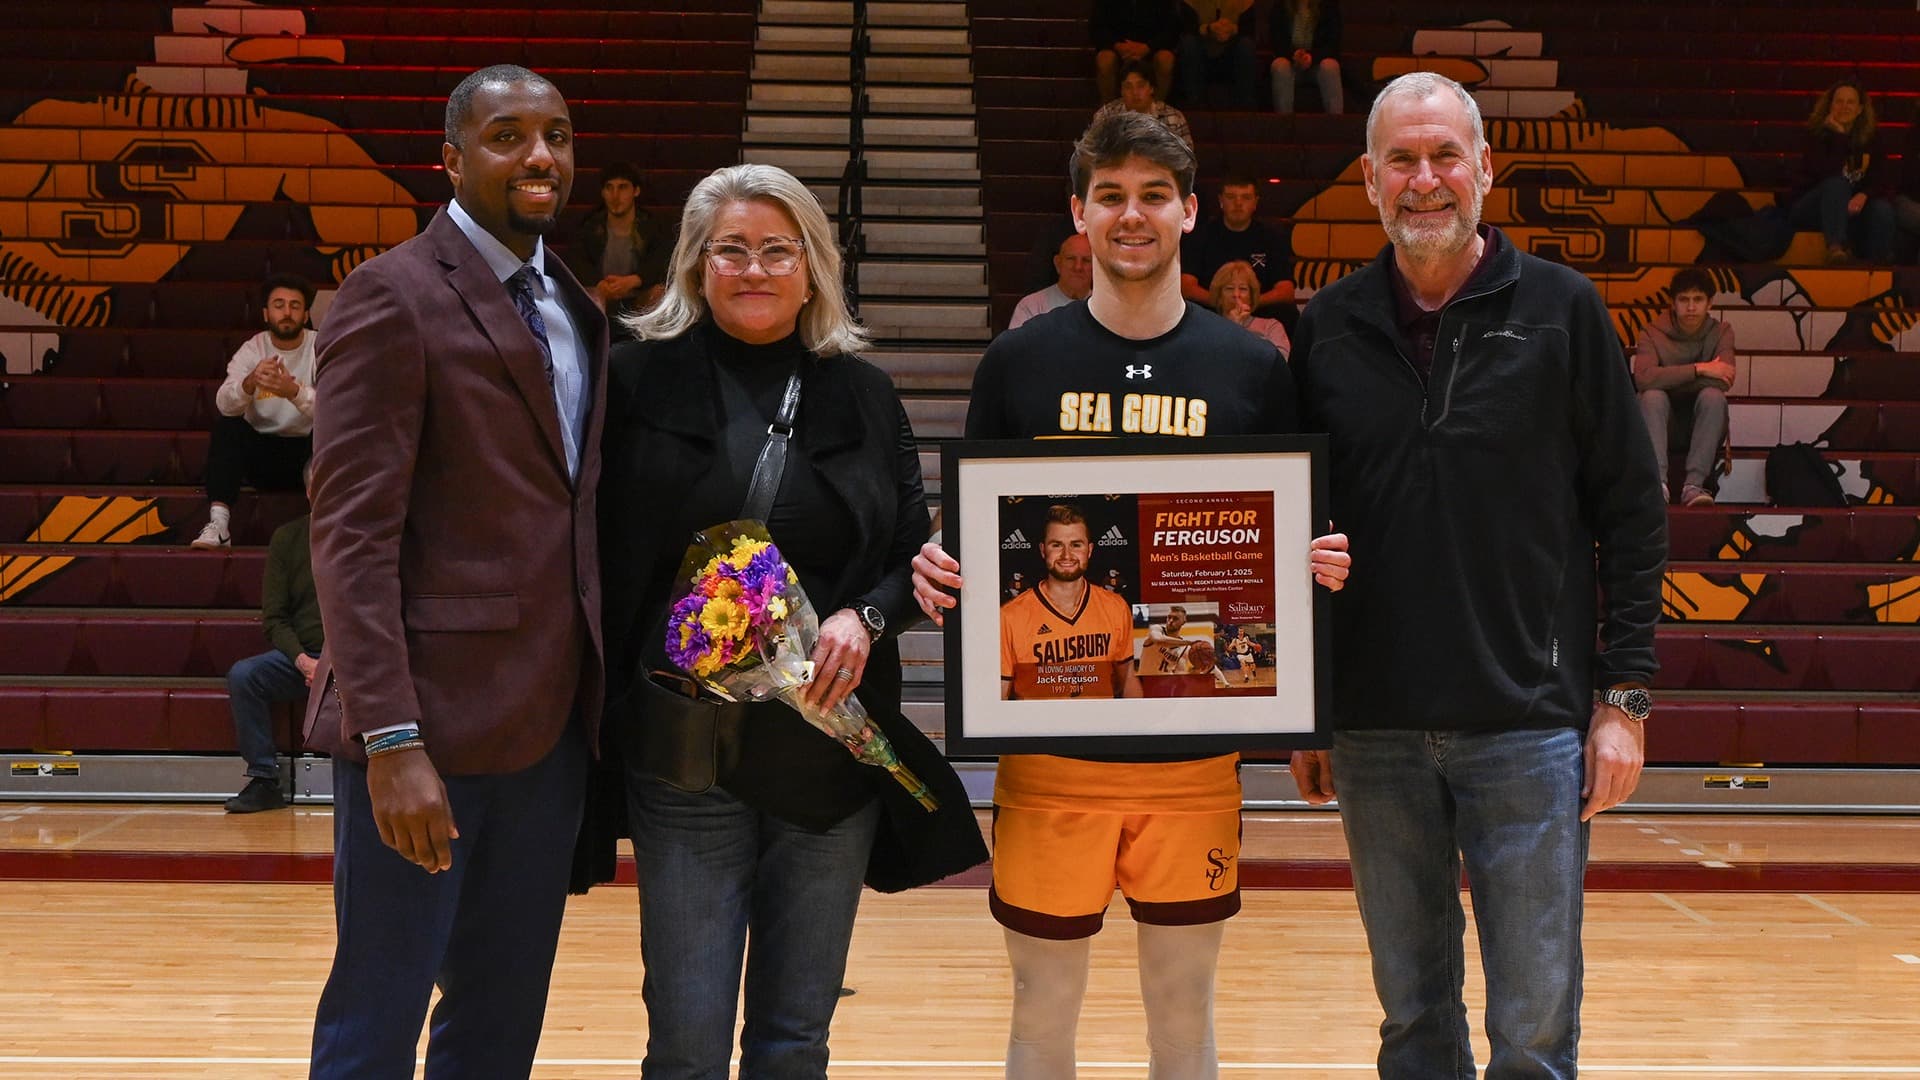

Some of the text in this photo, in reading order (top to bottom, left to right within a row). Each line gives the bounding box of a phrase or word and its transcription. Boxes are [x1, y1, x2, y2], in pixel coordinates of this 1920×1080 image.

[44, 138, 218, 259] S
[1494, 161, 1651, 282] S
[1059, 391, 1208, 437] SEA GULLS
[1155, 510, 1257, 528] FIGHT FOR
[1097, 538, 1128, 546] adidas
[1153, 528, 1260, 546] FERGUSON
[1001, 541, 1031, 550] adidas
[1150, 551, 1263, 562] Men's Basketball Game
[1161, 570, 1194, 578] Saturday,
[1195, 569, 1226, 577] February
[1233, 568, 1253, 576] 2025
[1228, 602, 1265, 614] Salisbury
[1033, 633, 1111, 666] SALISBURY
[1065, 665, 1088, 673] MEMORY
[1089, 664, 1096, 672] OF
[1037, 675, 1098, 684] Jack Ferguson
